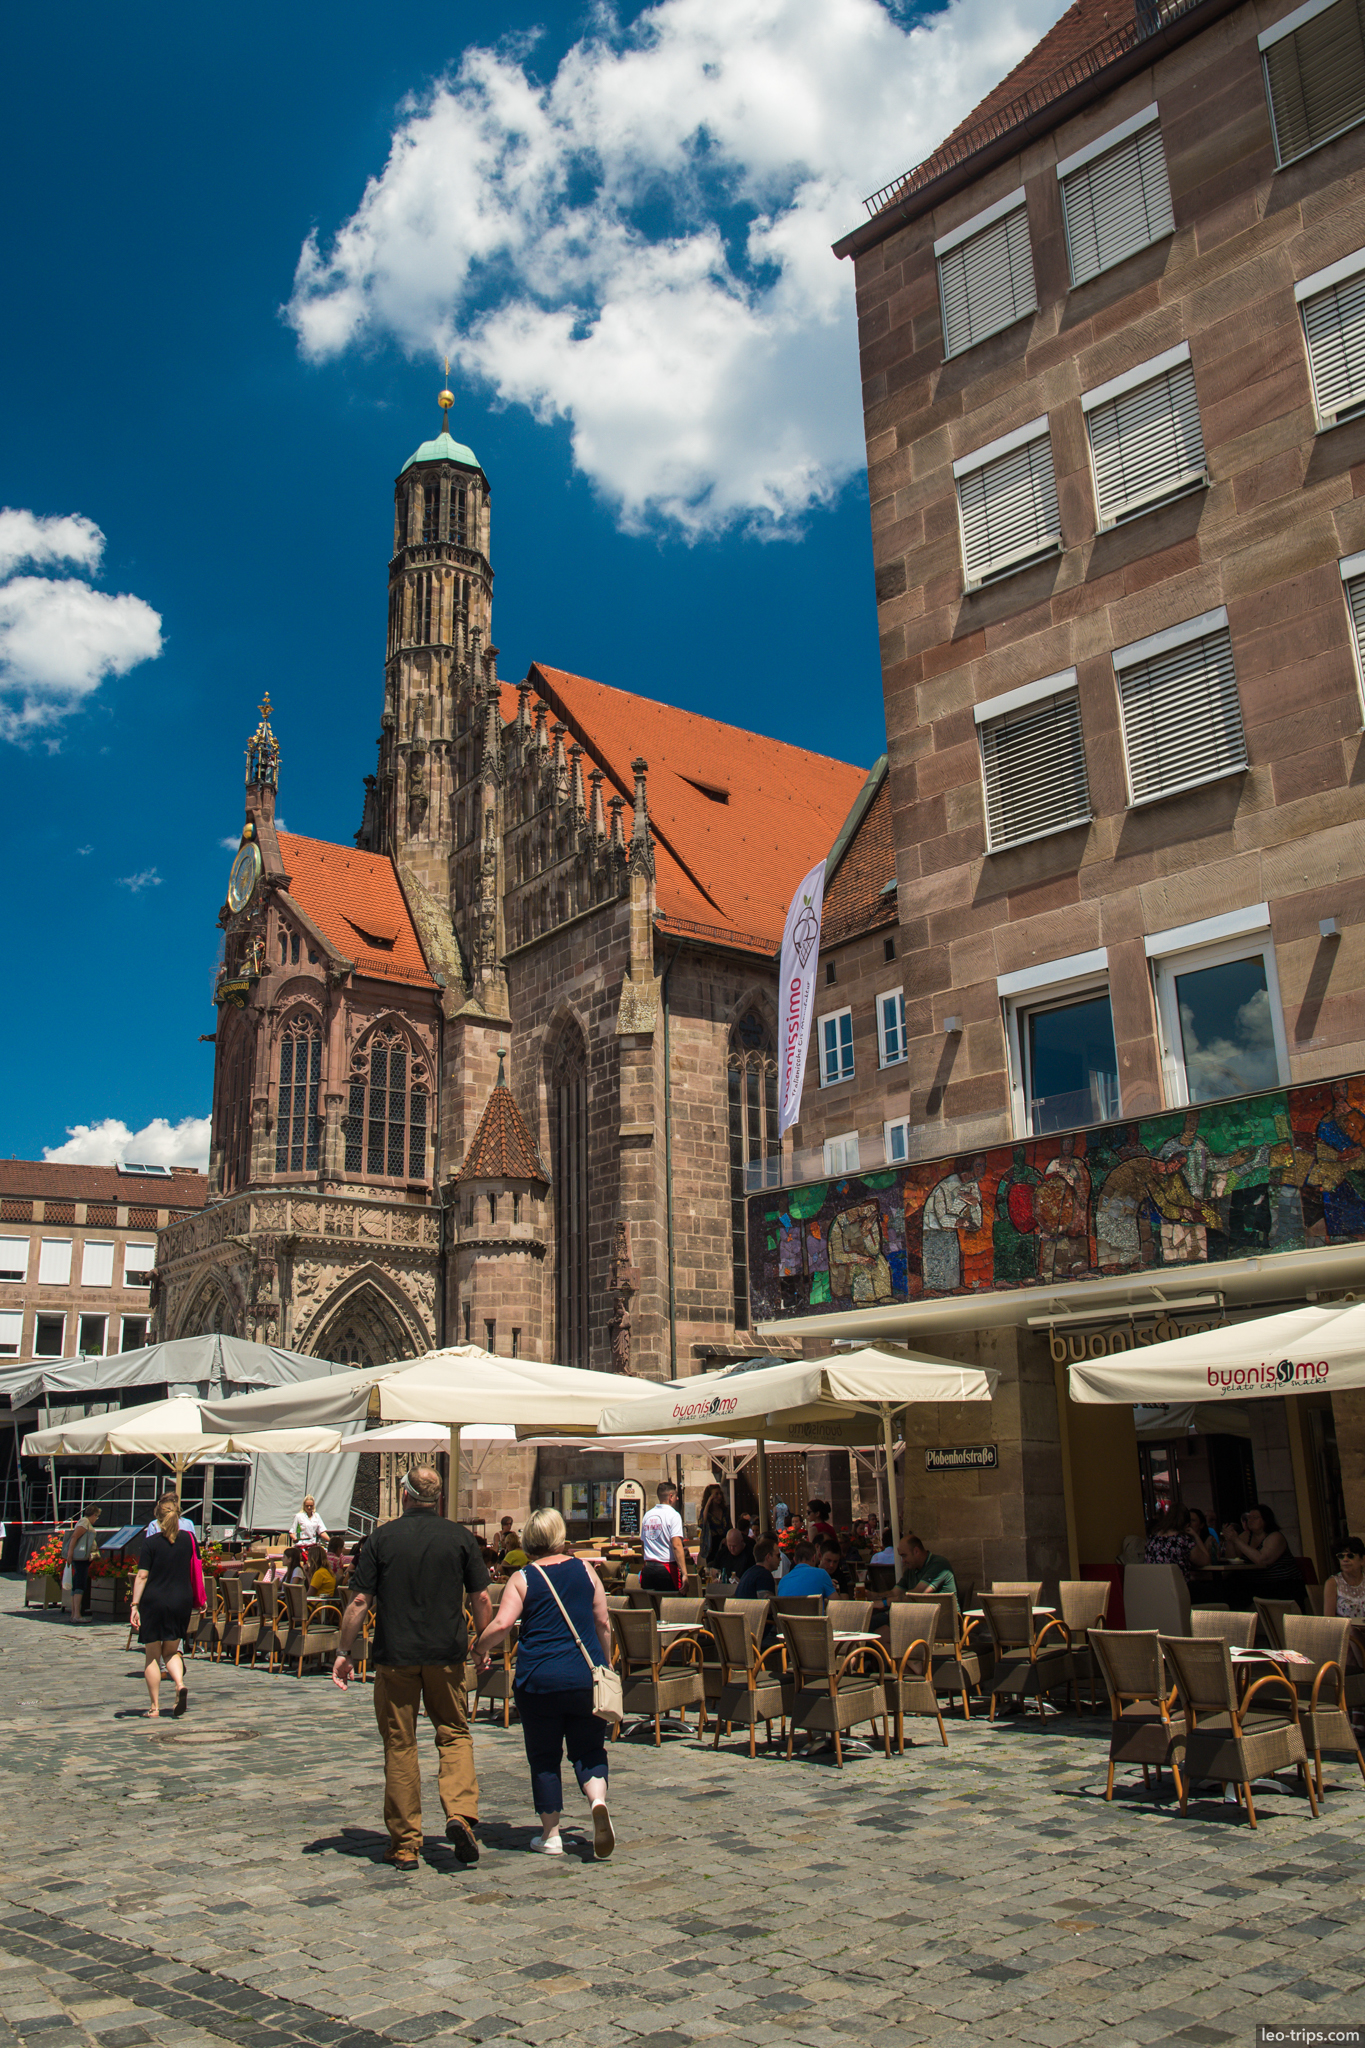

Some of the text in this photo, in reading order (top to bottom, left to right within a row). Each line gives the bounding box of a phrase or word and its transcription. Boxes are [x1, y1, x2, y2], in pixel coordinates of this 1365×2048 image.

[1207, 1359, 1329, 1387] buonissimo
[1220, 1382, 1255, 1396] gelato
[1291, 1375, 1327, 1387] snacks
[672, 1396, 738, 1418] buonissimo
[927, 1447, 994, 1466] Plobenhofstraße
